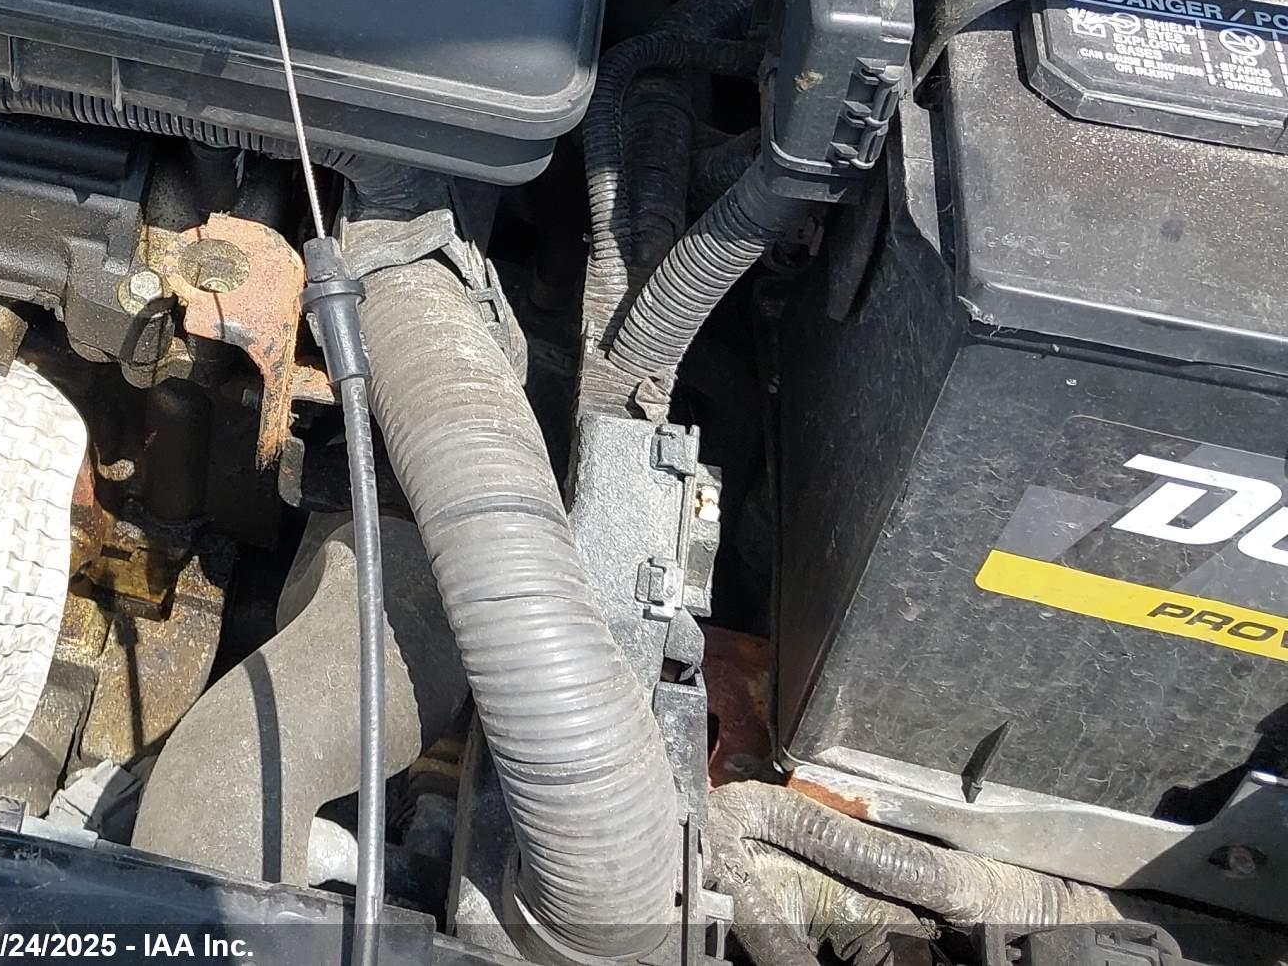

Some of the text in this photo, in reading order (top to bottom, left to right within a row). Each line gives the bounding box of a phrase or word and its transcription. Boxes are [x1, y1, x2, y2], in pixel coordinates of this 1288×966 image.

[1144, 18, 1197, 37] SHIELD
[1147, 29, 1185, 44] EYES
[1113, 33, 1192, 55] EXPLOSIVE
[1115, 44, 1163, 61] GASES
[1079, 47, 1205, 77] CAN CAUSE BLINDNESS
[1230, 53, 1258, 67] NO
[1114, 62, 1175, 81] OR INJURY
[1220, 62, 1272, 78] SPARKS
[1222, 71, 1273, 87] FLAMES
[1224, 80, 1284, 98] SMOKING
[1147, 602, 1288, 648] PRO
